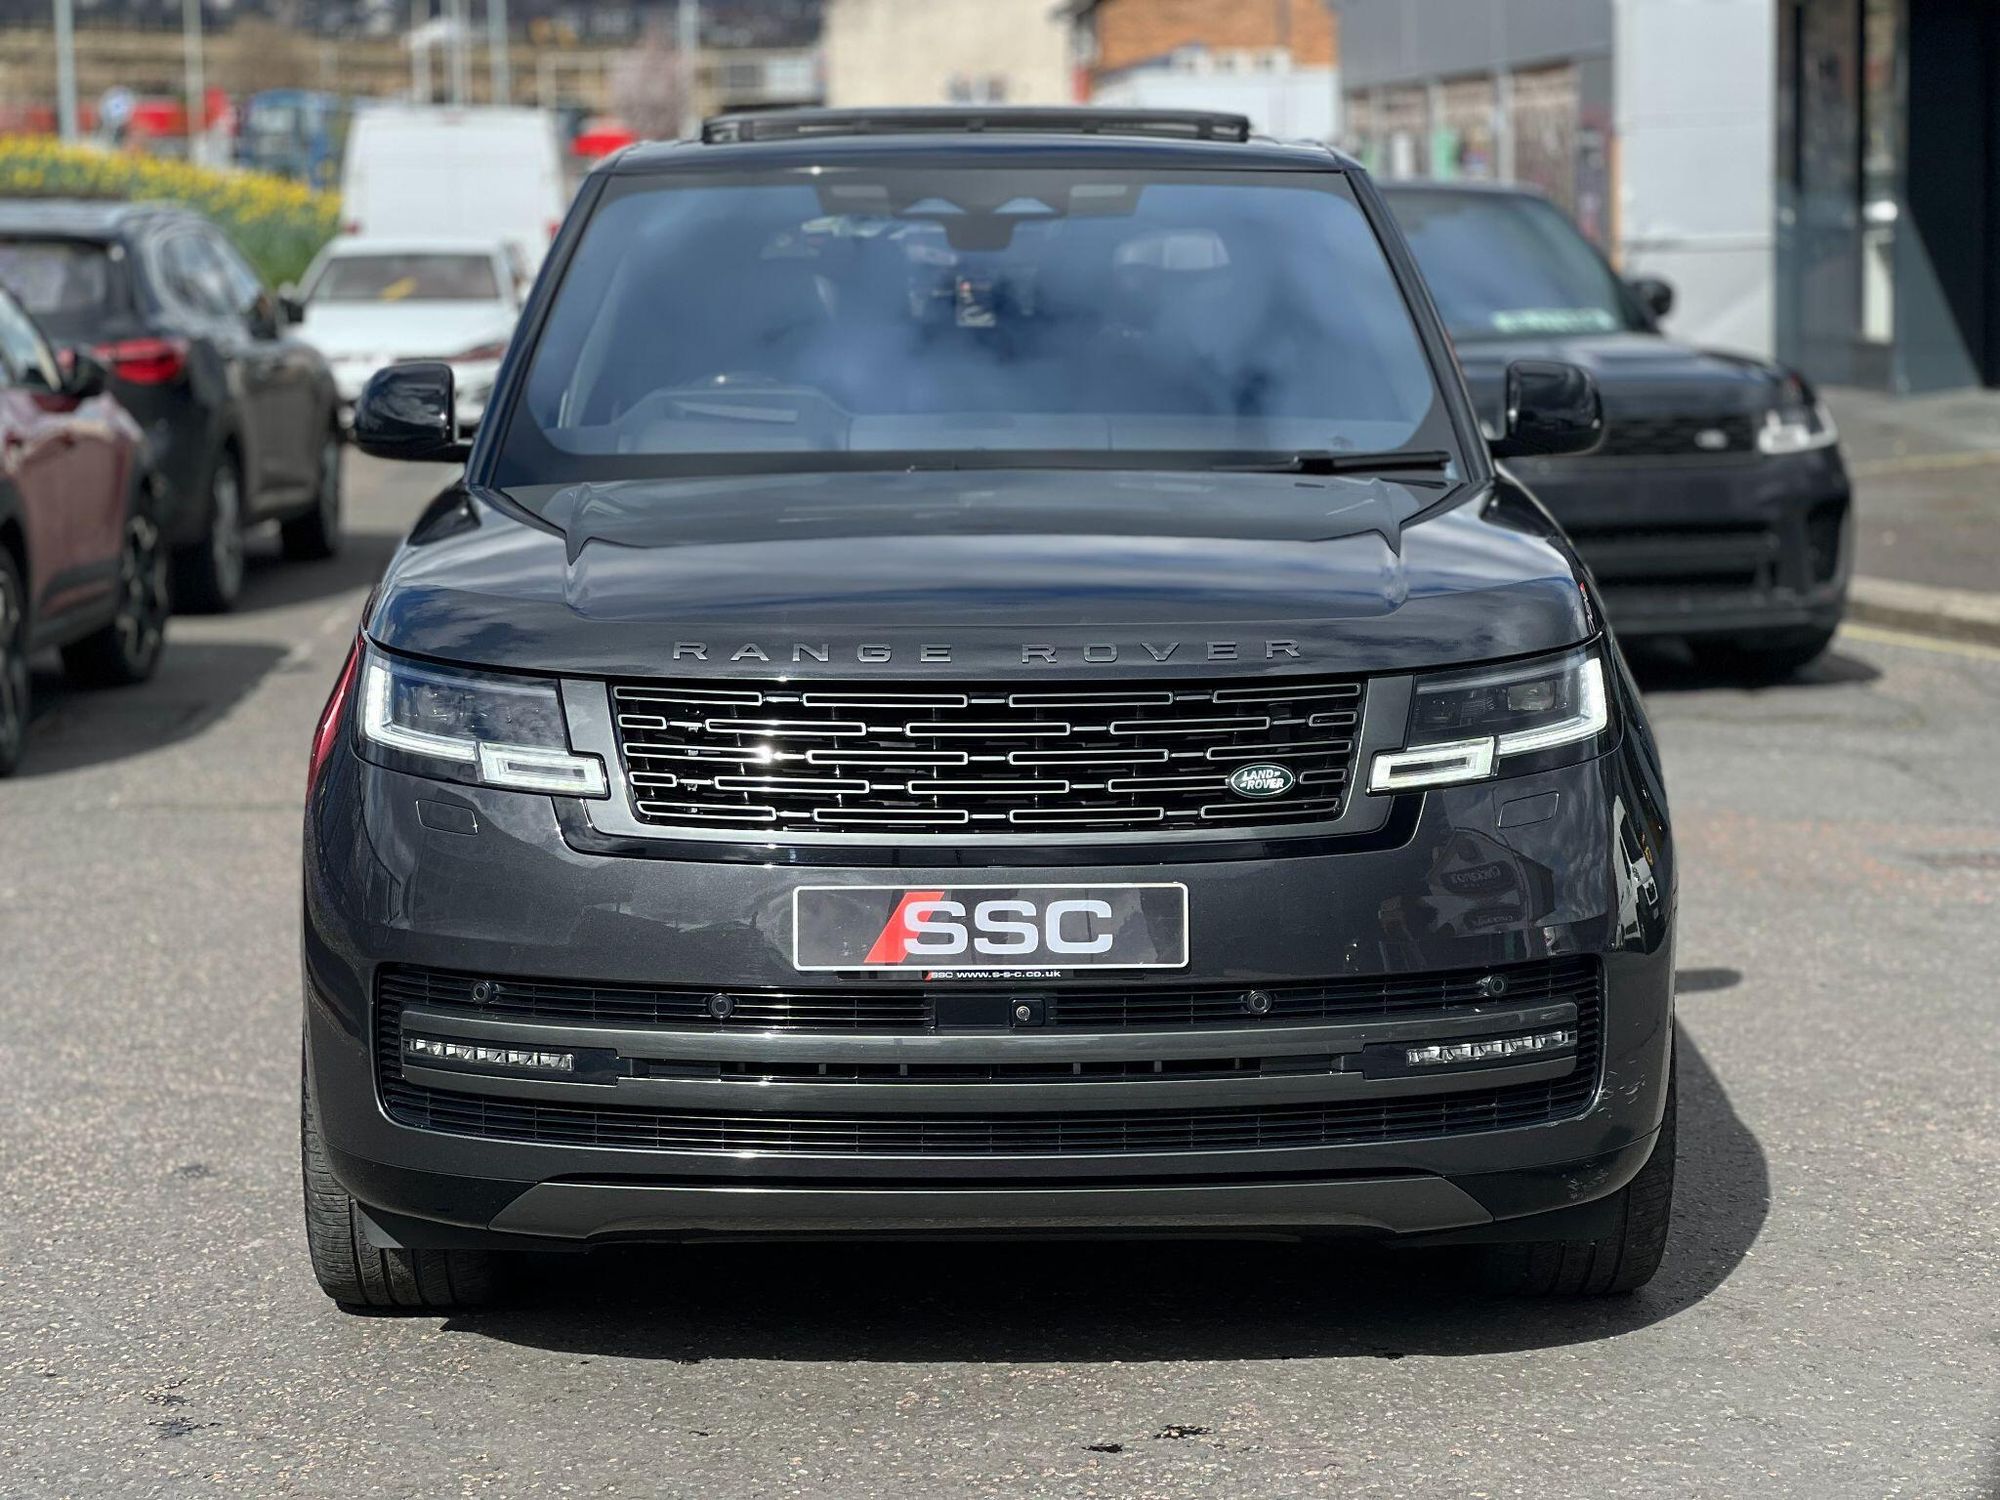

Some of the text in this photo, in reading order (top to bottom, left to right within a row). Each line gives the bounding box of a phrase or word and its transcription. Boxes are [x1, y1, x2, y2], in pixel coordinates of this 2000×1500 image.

[672, 638, 1302, 664] RANGE ROVER
[1243, 769, 1273, 780] LAND
[1247, 778, 1284, 789] ROVER
[903, 899, 1114, 955] SSC
[956, 970, 1062, 979] www.s-s-c.co.uk
